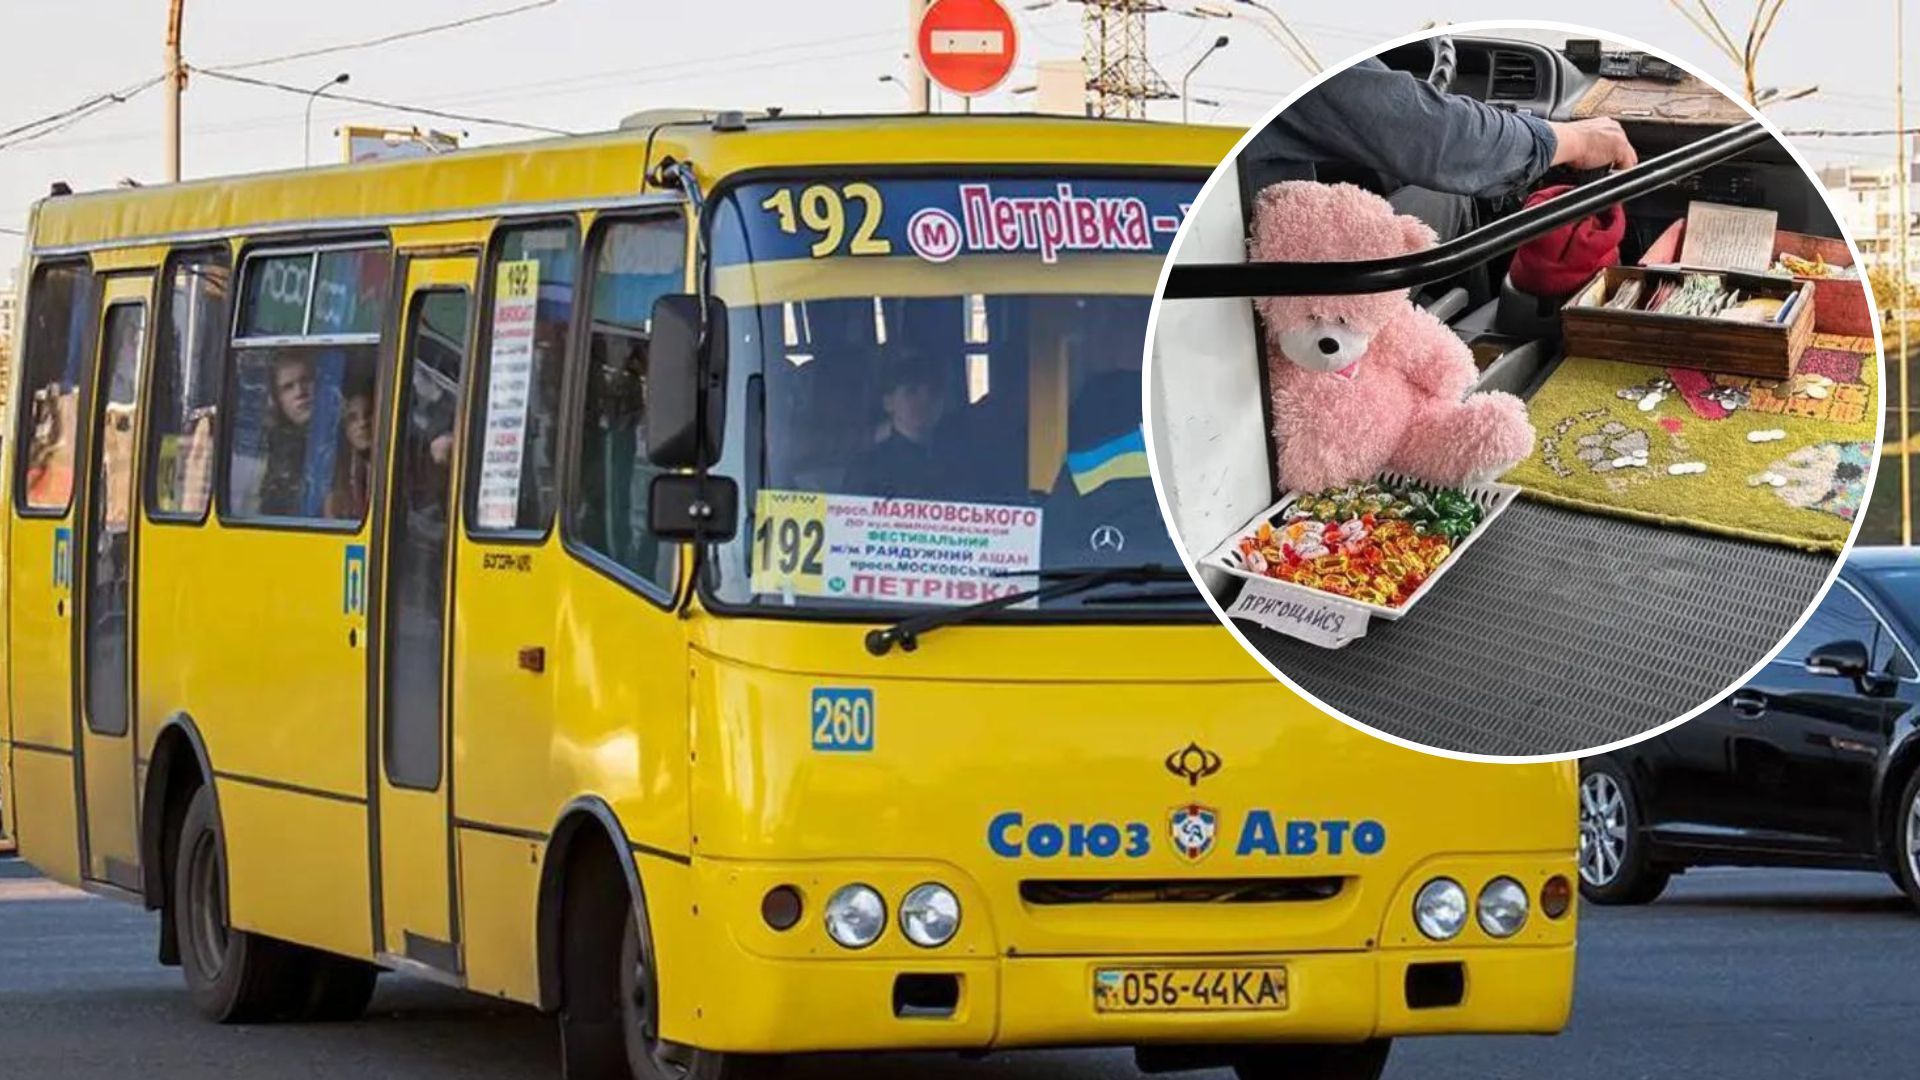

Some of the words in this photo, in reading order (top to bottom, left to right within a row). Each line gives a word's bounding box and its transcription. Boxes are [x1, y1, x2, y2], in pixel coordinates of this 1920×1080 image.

[762, 182, 892, 258] 192
[757, 516, 825, 575] 192
[814, 697, 870, 745] 260
[987, 811, 1151, 858] Союз
[1235, 809, 1387, 857] Авто
